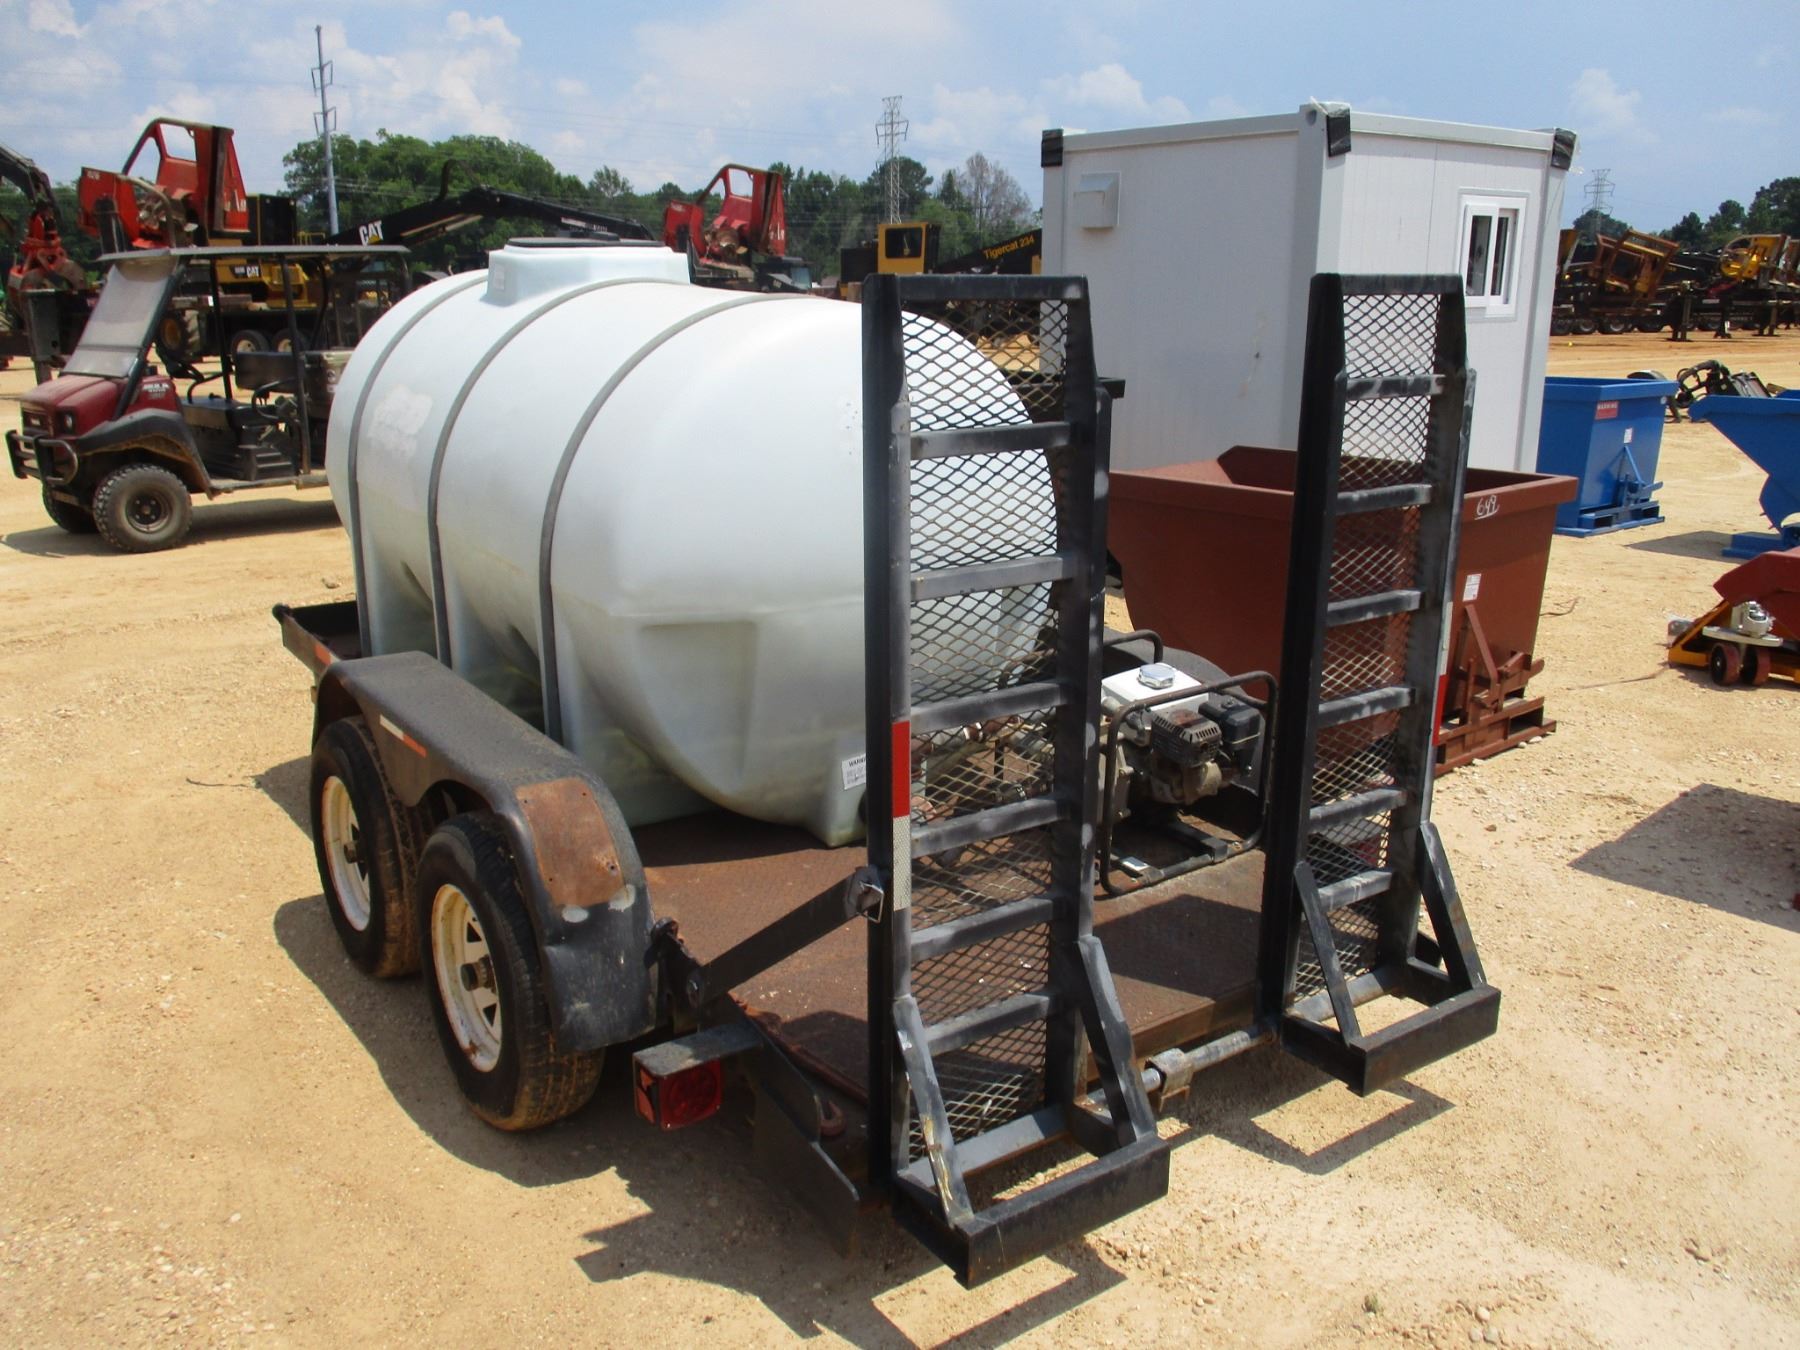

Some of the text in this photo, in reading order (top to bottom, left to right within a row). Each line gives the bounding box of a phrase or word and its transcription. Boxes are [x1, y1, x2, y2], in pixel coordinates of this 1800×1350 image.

[359, 220, 384, 247] CAT
[984, 235, 1034, 259] Tigercat 234
[246, 266, 259, 278] CAT
